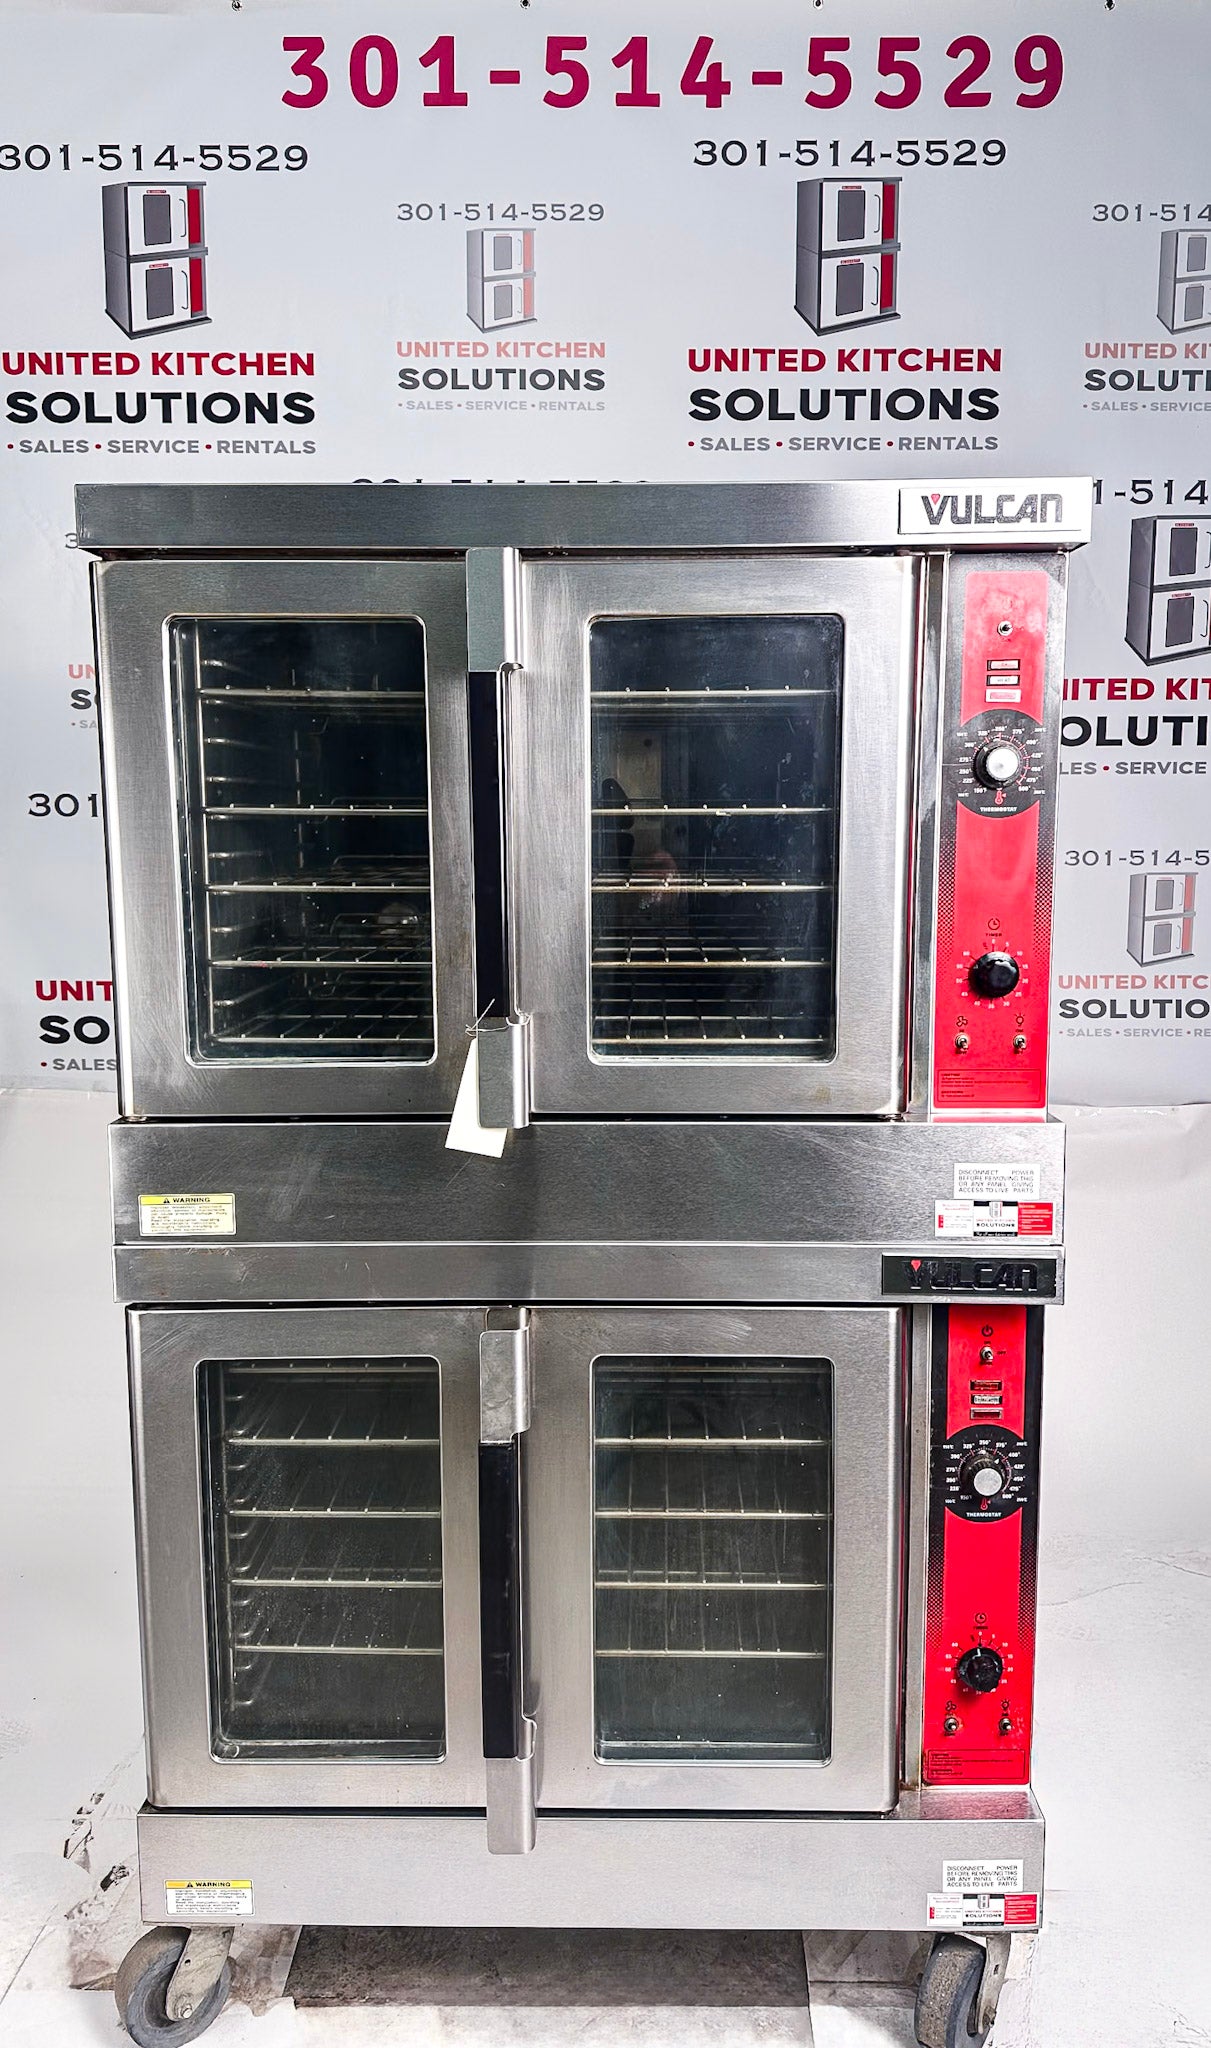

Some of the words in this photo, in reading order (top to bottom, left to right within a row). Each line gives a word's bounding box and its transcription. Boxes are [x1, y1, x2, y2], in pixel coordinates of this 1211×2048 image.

[282, 35, 1063, 109] 301-514-5529
[0, 145, 307, 171] 301-514-5529
[694, 140, 1006, 166] 301-514-5529
[398, 204, 604, 221] 301-514-5529
[397, 342, 489, 357] UNITED
[497, 342, 605, 358] KITCHEN
[1085, 343, 1177, 359] UNITED
[1185, 343, 1211, 359] KI
[3, 352, 140, 375] UNITED
[152, 353, 314, 375] KITCHEN
[689, 349, 826, 372] UNITED
[838, 349, 1001, 372] KITCHEN
[398, 368, 605, 391] SOLUTIONS
[6, 392, 314, 424] SOLUTIONS
[406, 401, 459, 410] SALES
[466, 401, 527, 410] SERVICE
[539, 401, 605, 411] RENTALS
[689, 388, 999, 421] SOLUTIONS
[1091, 402, 1138, 411] SALES
[1151, 402, 1211, 411] SERVICE
[20, 440, 89, 453] SALES
[108, 440, 199, 453] SERVICE
[217, 441, 316, 454] RENTALS
[700, 438, 770, 451] SALES
[789, 437, 880, 450] SERVICE
[899, 437, 998, 450] RENTALS
[921, 494, 1063, 525] VULCAN
[1062, 678, 1155, 700] ITED
[1115, 762, 1207, 775] SERVICE
[1065, 850, 1210, 866] 301-514-5
[1059, 975, 1147, 989] UNITED
[1059, 999, 1210, 1018] SOLUTIO
[1067, 1029, 1112, 1038] SALES
[1124, 1029, 1183, 1038] SERVICE
[52, 1058, 116, 1071] SALES
[901, 1260, 1039, 1290] VULCAN
